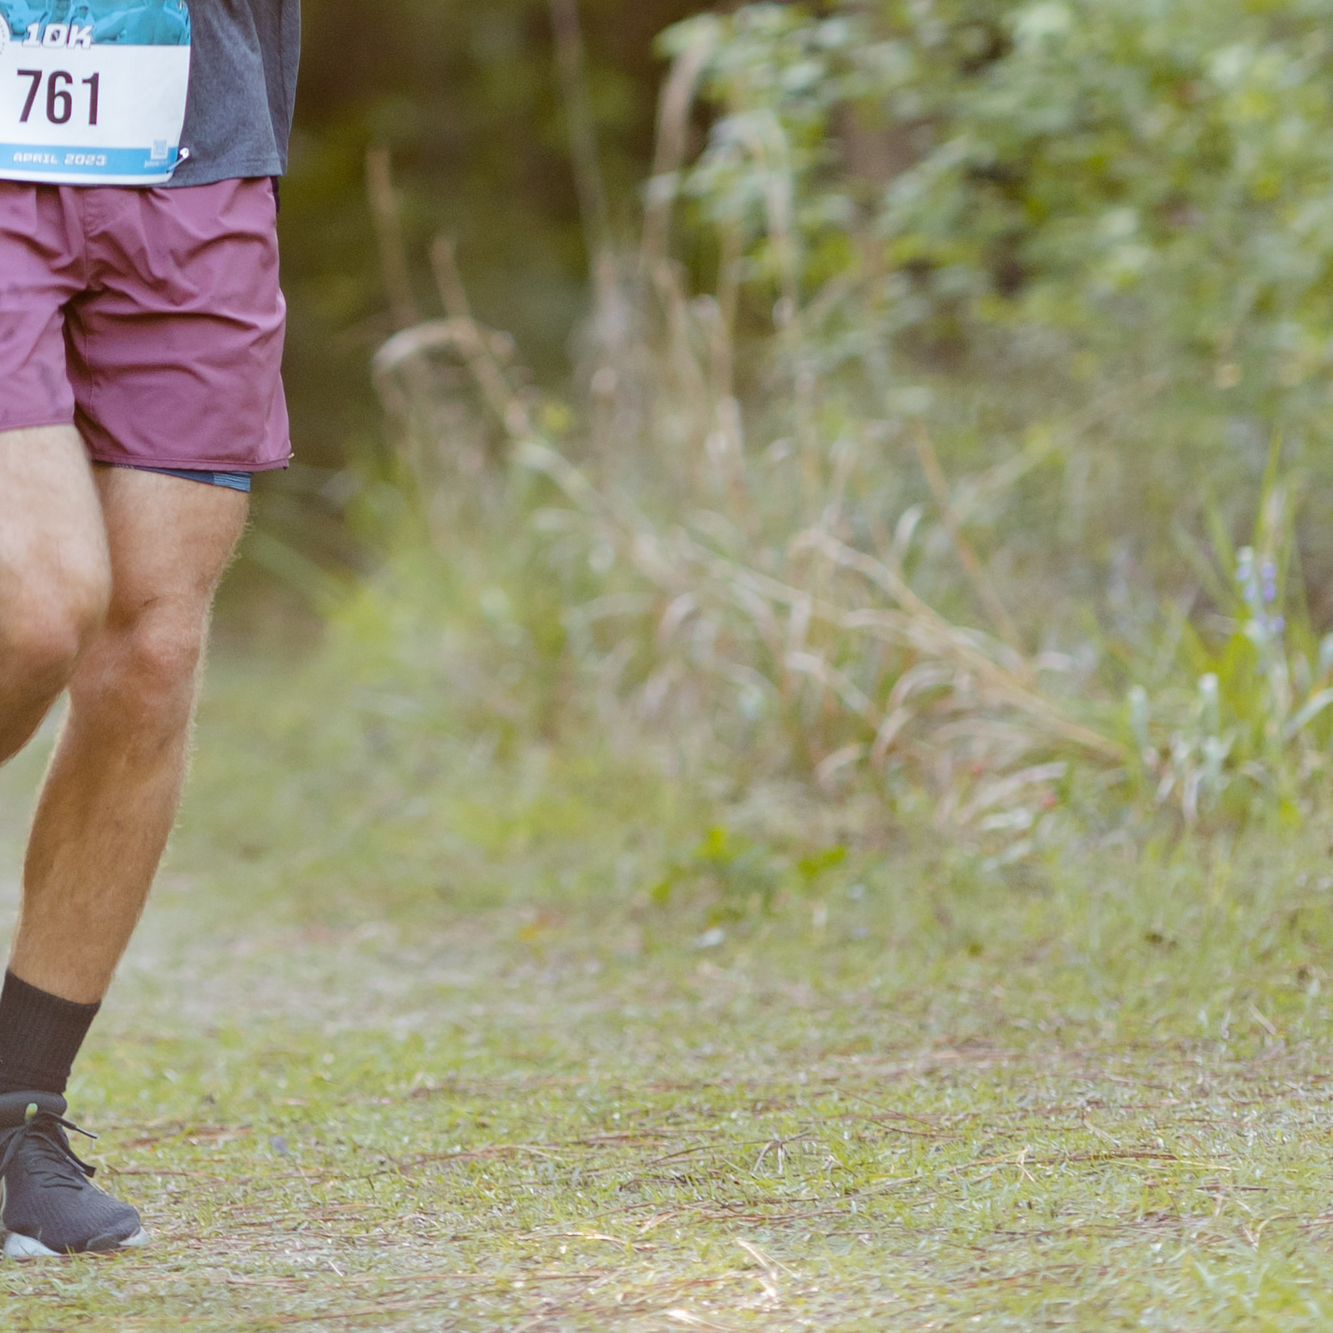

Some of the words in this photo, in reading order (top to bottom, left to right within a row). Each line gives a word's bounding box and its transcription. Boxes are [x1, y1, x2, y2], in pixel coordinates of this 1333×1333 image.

[21, 22, 93, 50] 10K
[17, 69, 100, 126] 761
[12, 152, 58, 165] APRIL
[64, 153, 107, 166] 2023
